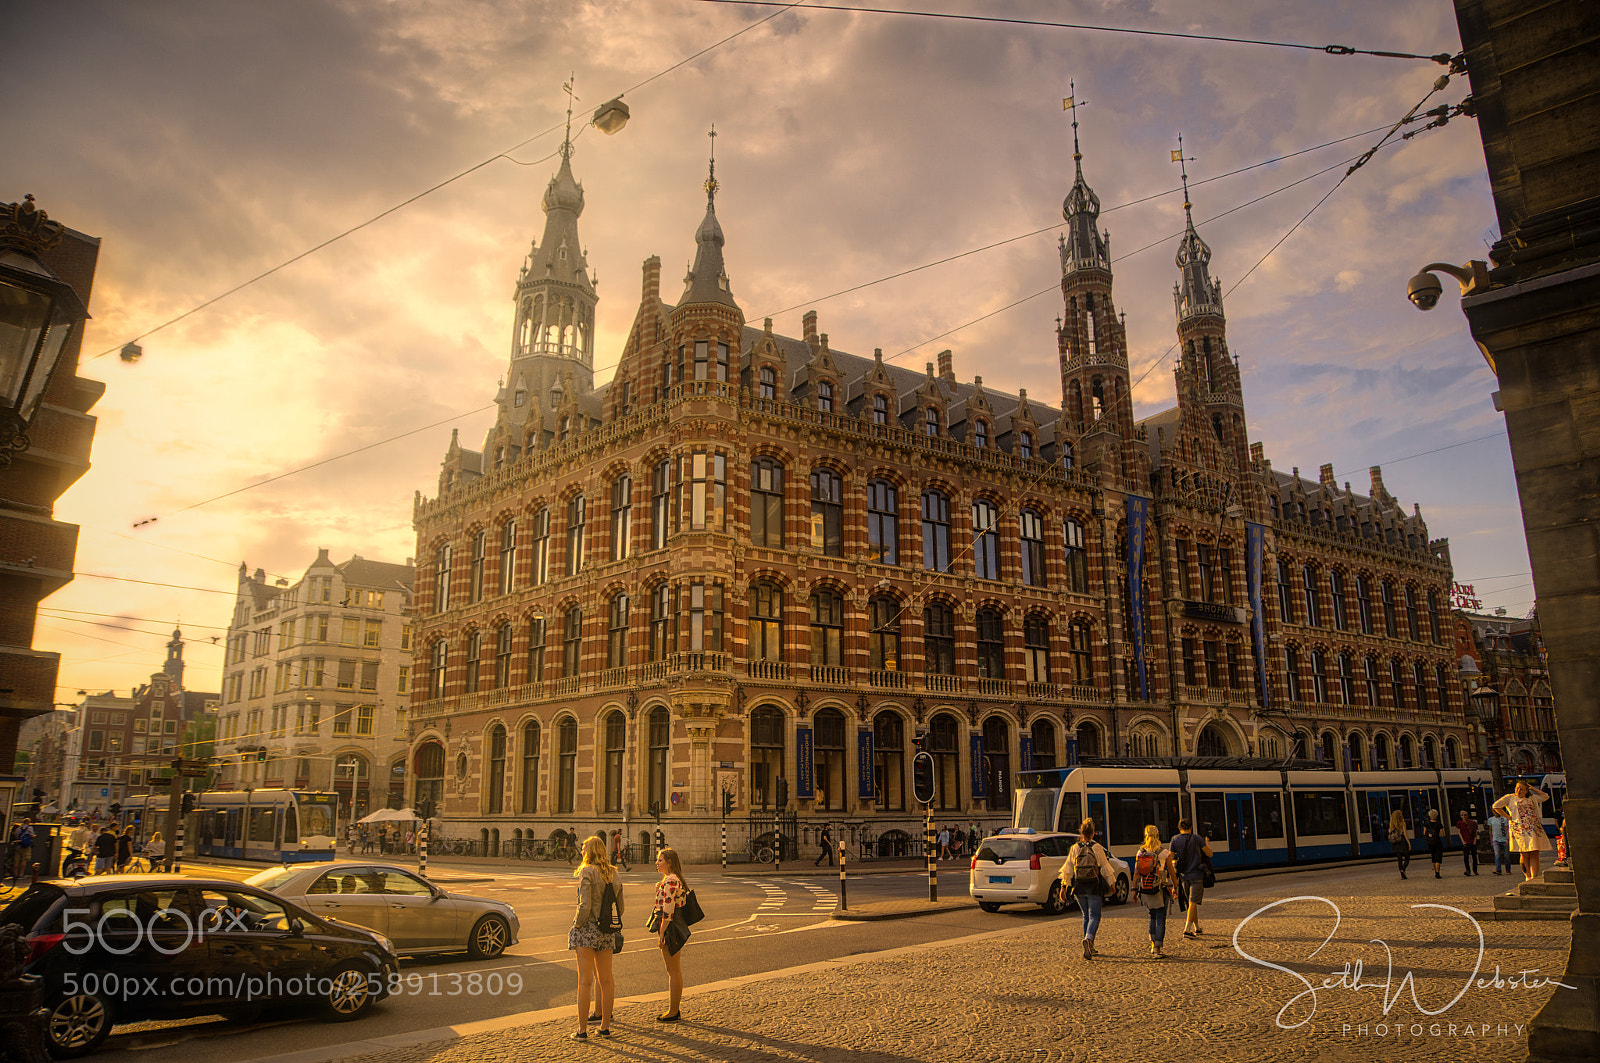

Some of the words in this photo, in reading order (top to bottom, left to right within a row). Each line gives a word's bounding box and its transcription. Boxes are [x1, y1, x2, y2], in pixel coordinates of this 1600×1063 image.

[1133, 500, 1143, 581] MAGNA
[1252, 527, 1261, 602] MAGNA
[1135, 590, 1144, 662] PLAZA
[1198, 603, 1239, 617] SHOPPING
[1036, 774, 1042, 785] 2
